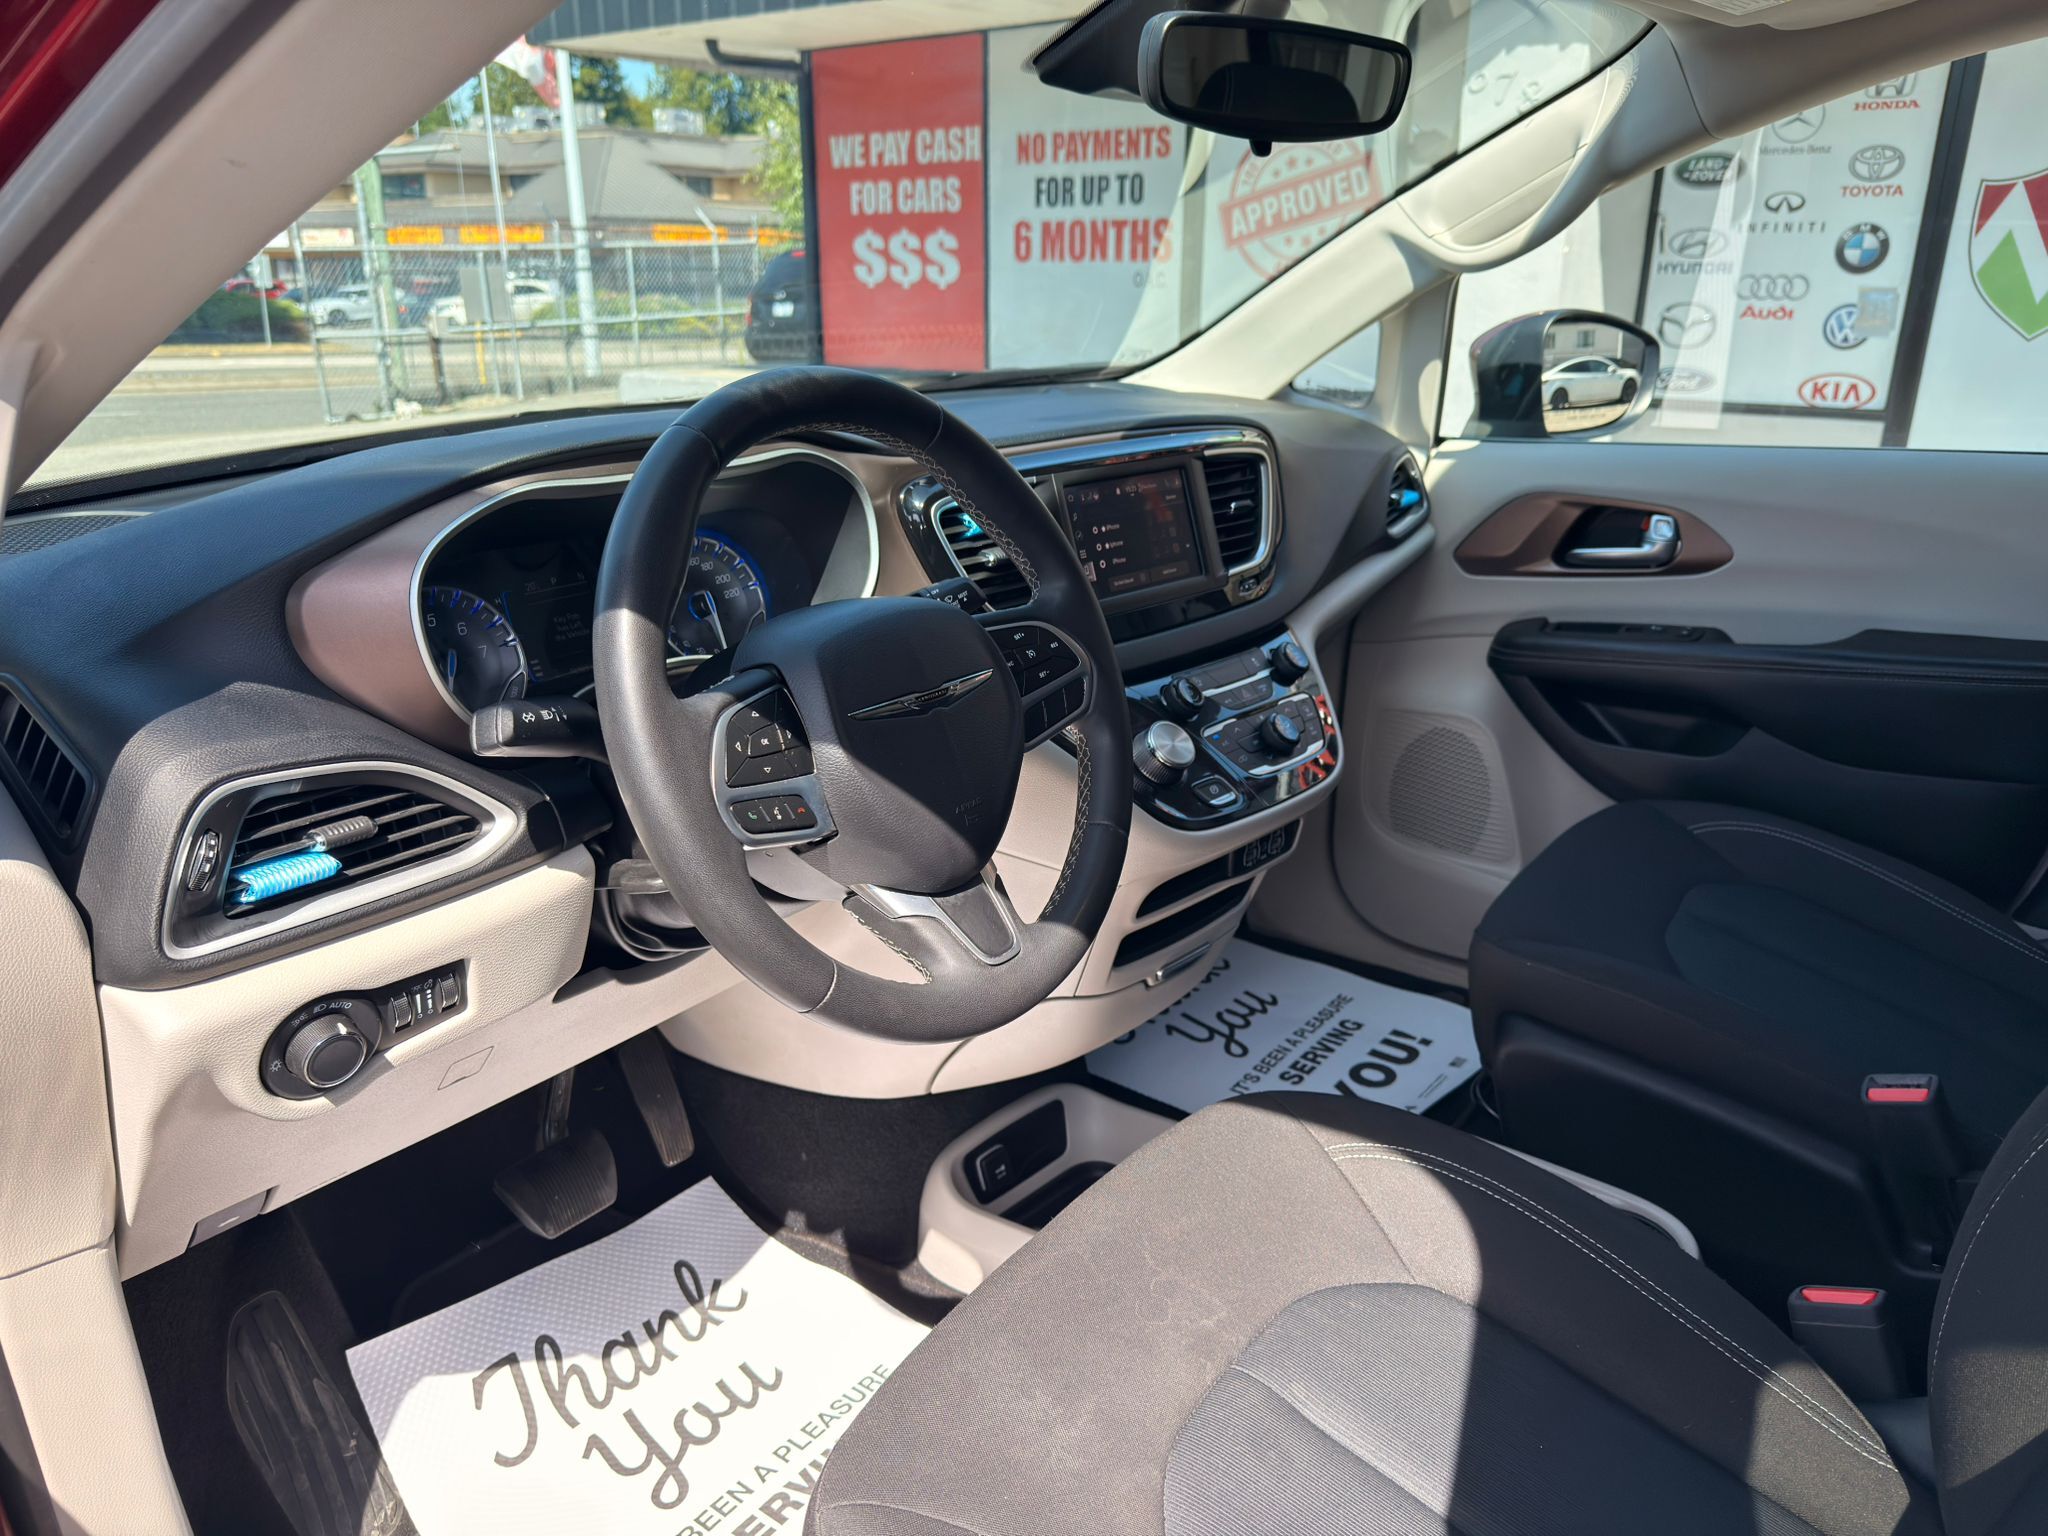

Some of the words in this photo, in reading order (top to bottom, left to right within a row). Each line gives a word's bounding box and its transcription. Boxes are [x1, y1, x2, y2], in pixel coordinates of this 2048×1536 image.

[1853, 99, 1920, 112] HONDA
[829, 133, 866, 169] WE
[868, 129, 913, 167] PAY
[915, 125, 982, 165] CASH
[1017, 133, 1046, 165] NO
[1052, 126, 1172, 162] PAYMENTS
[849, 181, 893, 215] FOR
[897, 176, 962, 213] CARS
[1035, 176, 1074, 208] FOR
[1081, 174, 1110, 206] UP
[1117, 173, 1145, 205] TO
[1230, 166, 1371, 239] APPROVED
[1840, 184, 1904, 198] TOYOTA
[1013, 221, 1034, 262] 6
[1041, 218, 1172, 263] MONTHS
[1737, 222, 1827, 234] INFINITI
[852, 228, 961, 290] $$$
[1739, 305, 1795, 320] Audi
[1811, 382, 1861, 401] KIA
[714, 573, 731, 585] 200
[723, 587, 740, 599] 220
[426, 612, 437, 627] 5
[457, 621, 469, 636] 6
[477, 645, 487, 659] 7
[329, 1001, 353, 1010] AUTO
[1293, 992, 1354, 1039] PLEASURE
[1165, 990, 1279, 1059] You
[1285, 1030, 1304, 1047] A
[1252, 1044, 1293, 1075] BEEN
[1278, 1018, 1365, 1085] SERVING
[471, 1259, 749, 1468] Thank
[582, 1361, 784, 1510] You
[754, 1464, 779, 1484] A
